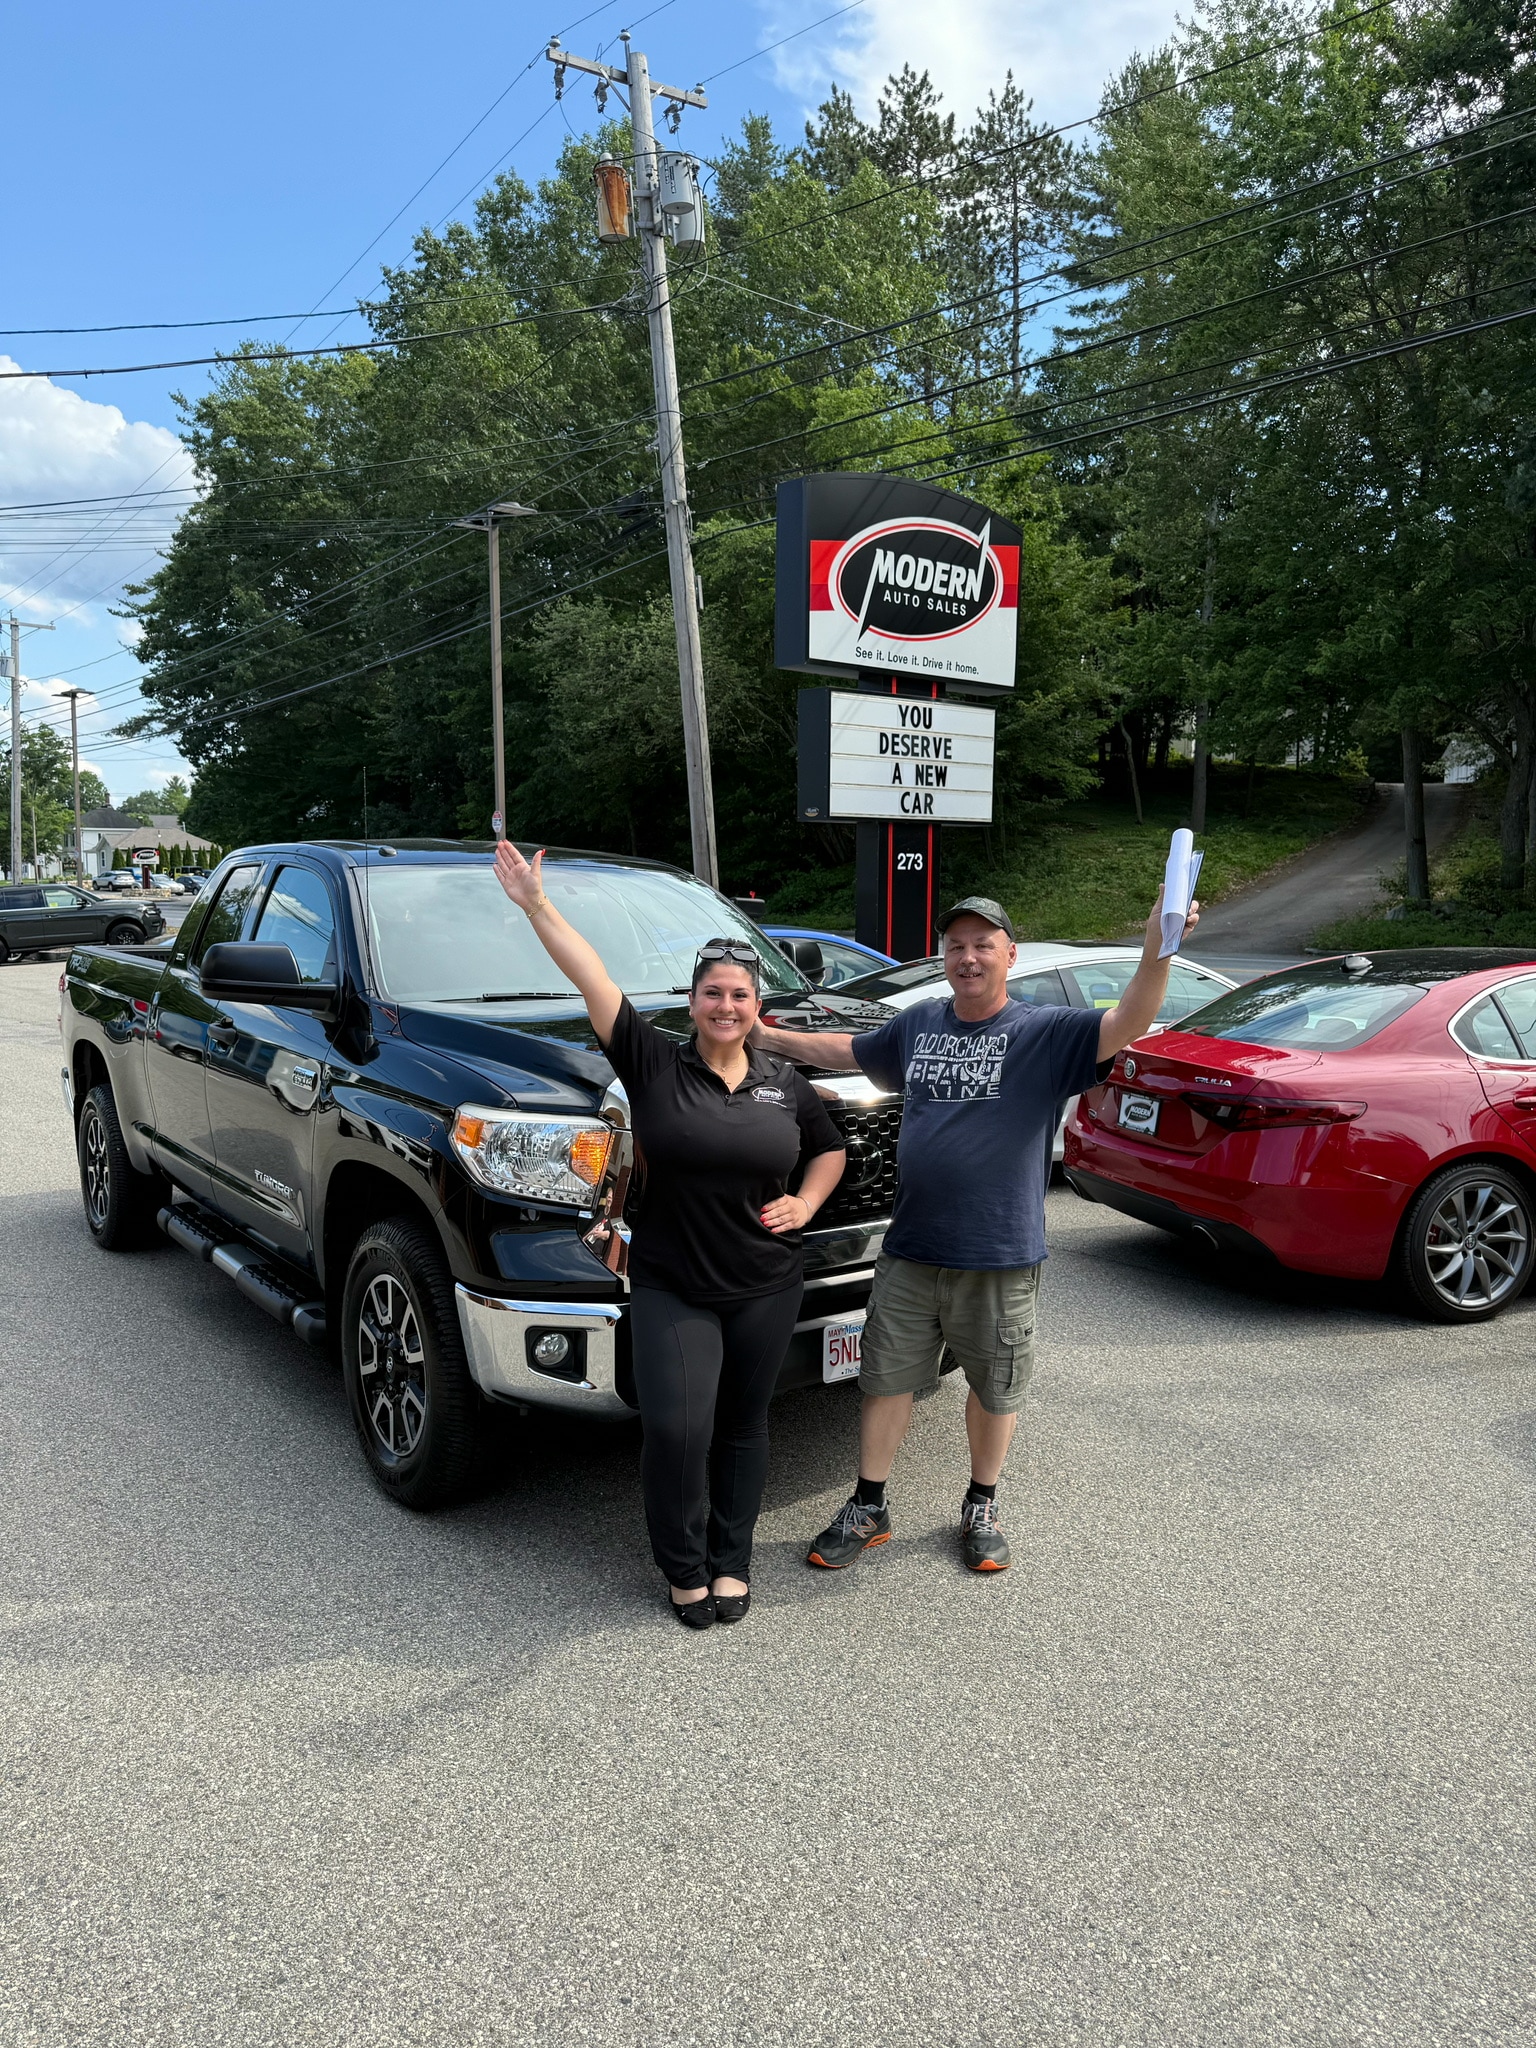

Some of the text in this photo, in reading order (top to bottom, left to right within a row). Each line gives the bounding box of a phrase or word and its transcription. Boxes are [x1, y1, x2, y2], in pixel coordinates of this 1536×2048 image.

[883, 589, 967, 616] AUTO SALES
[855, 646, 980, 675] See it. Love it. Drive it home.
[898, 704, 933, 730] YOU
[879, 732, 952, 760] DESERVE
[892, 762, 948, 787] A NEW
[900, 791, 934, 815] CAR
[897, 852, 924, 871] 273
[914, 1033, 938, 1054] OLD
[254, 1168, 292, 1200] TUNDRA
